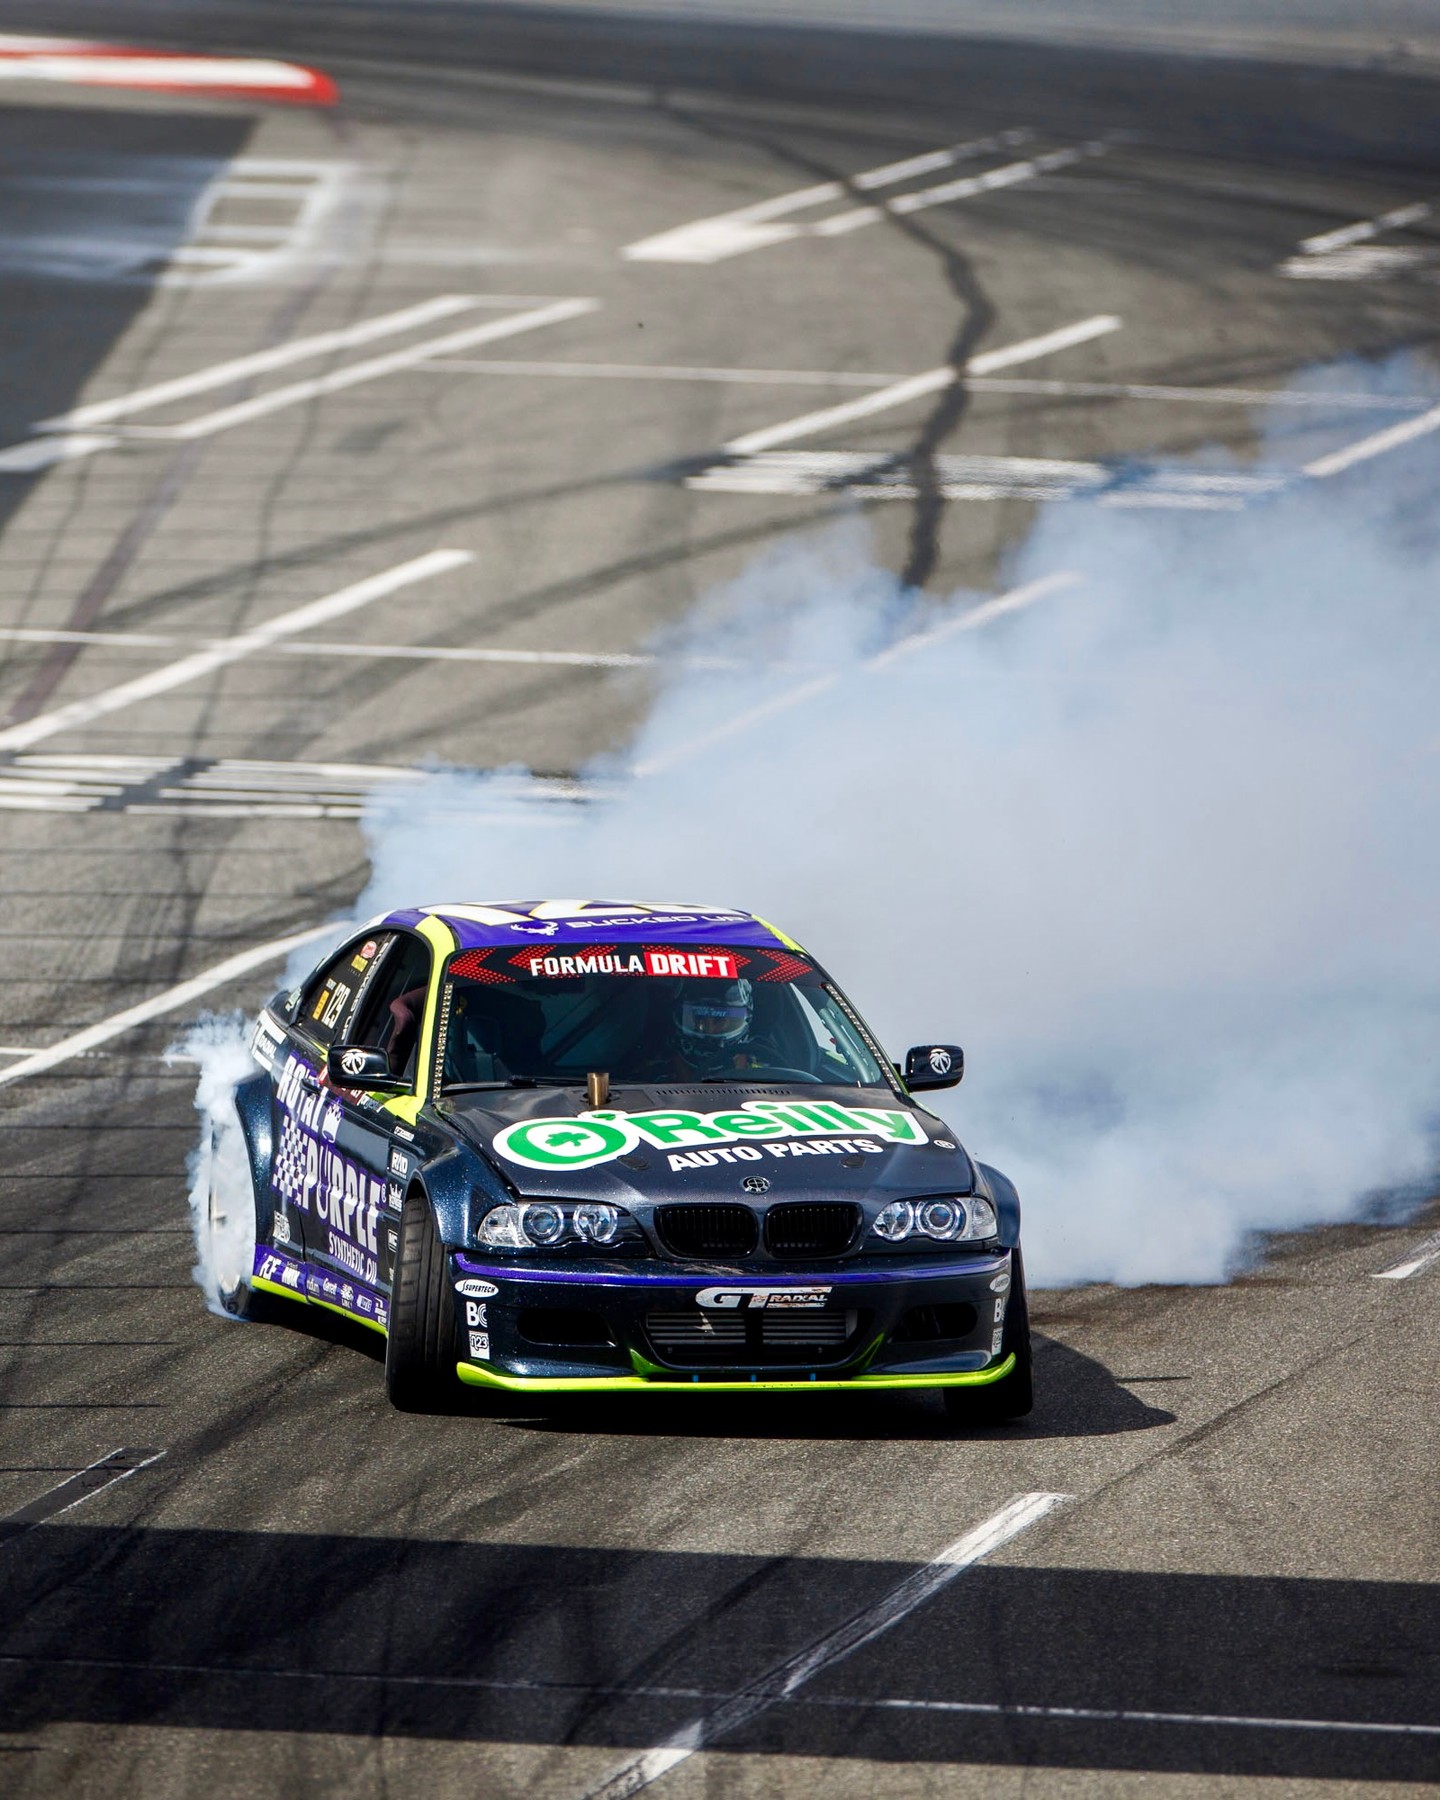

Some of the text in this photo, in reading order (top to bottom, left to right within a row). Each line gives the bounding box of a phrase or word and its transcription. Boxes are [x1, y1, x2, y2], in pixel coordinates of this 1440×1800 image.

[566, 915, 698, 929] BUCKED
[530, 953, 731, 977] FORMULA DRIFT
[276, 1053, 329, 1134] ROYAL
[493, 1101, 929, 1171] O'Reilly
[668, 1138, 883, 1172] AUTO PARTS
[301, 1137, 382, 1255] PURPLE
[328, 1231, 377, 1285] SYNTHETIC OIL
[465, 1283, 496, 1294] SUPERTECH
[696, 1286, 832, 1308] GT RADIAL
